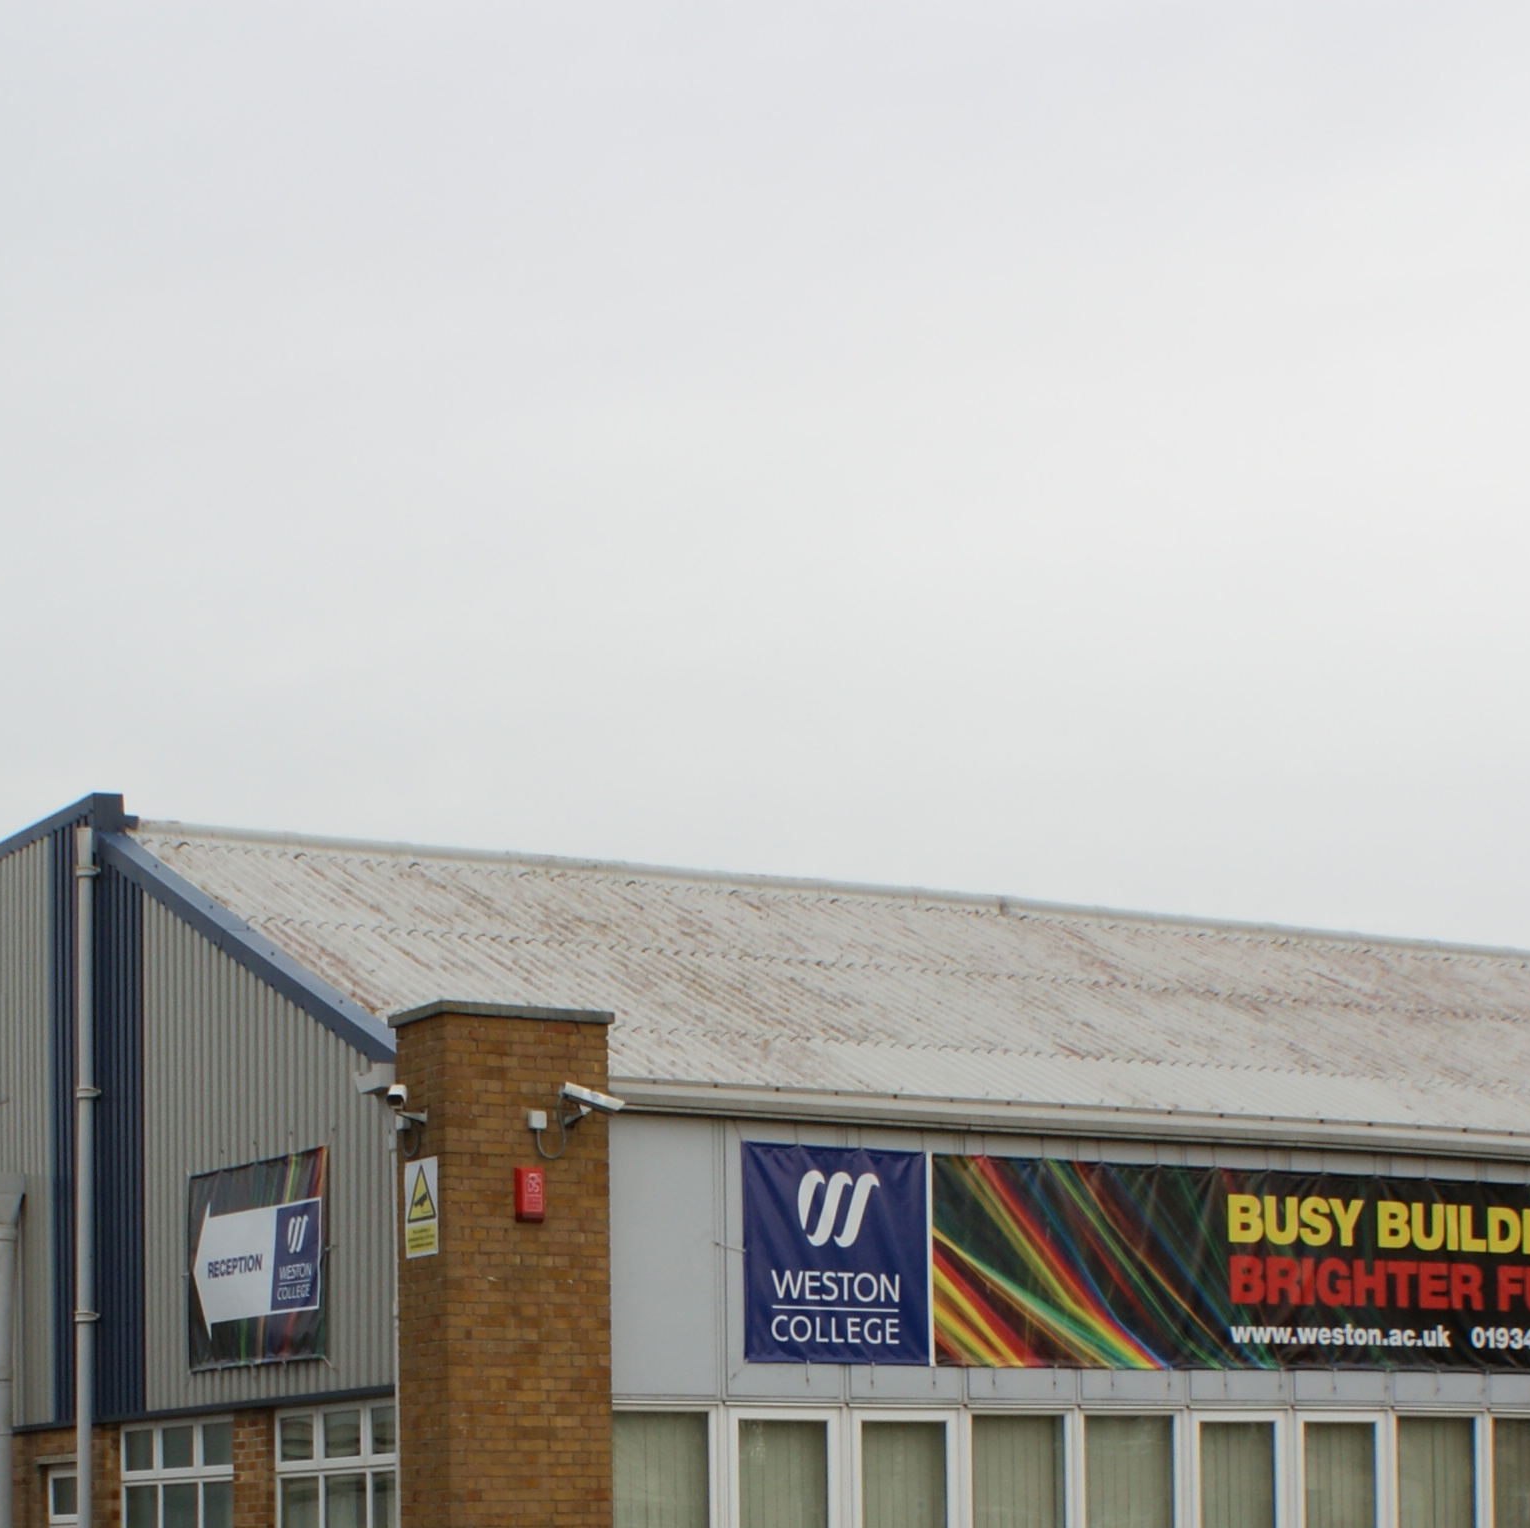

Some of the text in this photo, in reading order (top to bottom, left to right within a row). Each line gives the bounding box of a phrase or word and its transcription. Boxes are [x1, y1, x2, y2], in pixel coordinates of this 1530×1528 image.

[1227, 1194, 1365, 1247] BUSY
[208, 1253, 263, 1279] RECEPTION
[279, 1263, 312, 1280] WESTON
[277, 1284, 310, 1301] COLLEGE
[771, 1269, 900, 1303] WESTON
[1229, 1255, 1484, 1311] BRIGHTER
[771, 1315, 900, 1345] COLLEGE
[1230, 1323, 1451, 1348] www.weston.ac.uk
